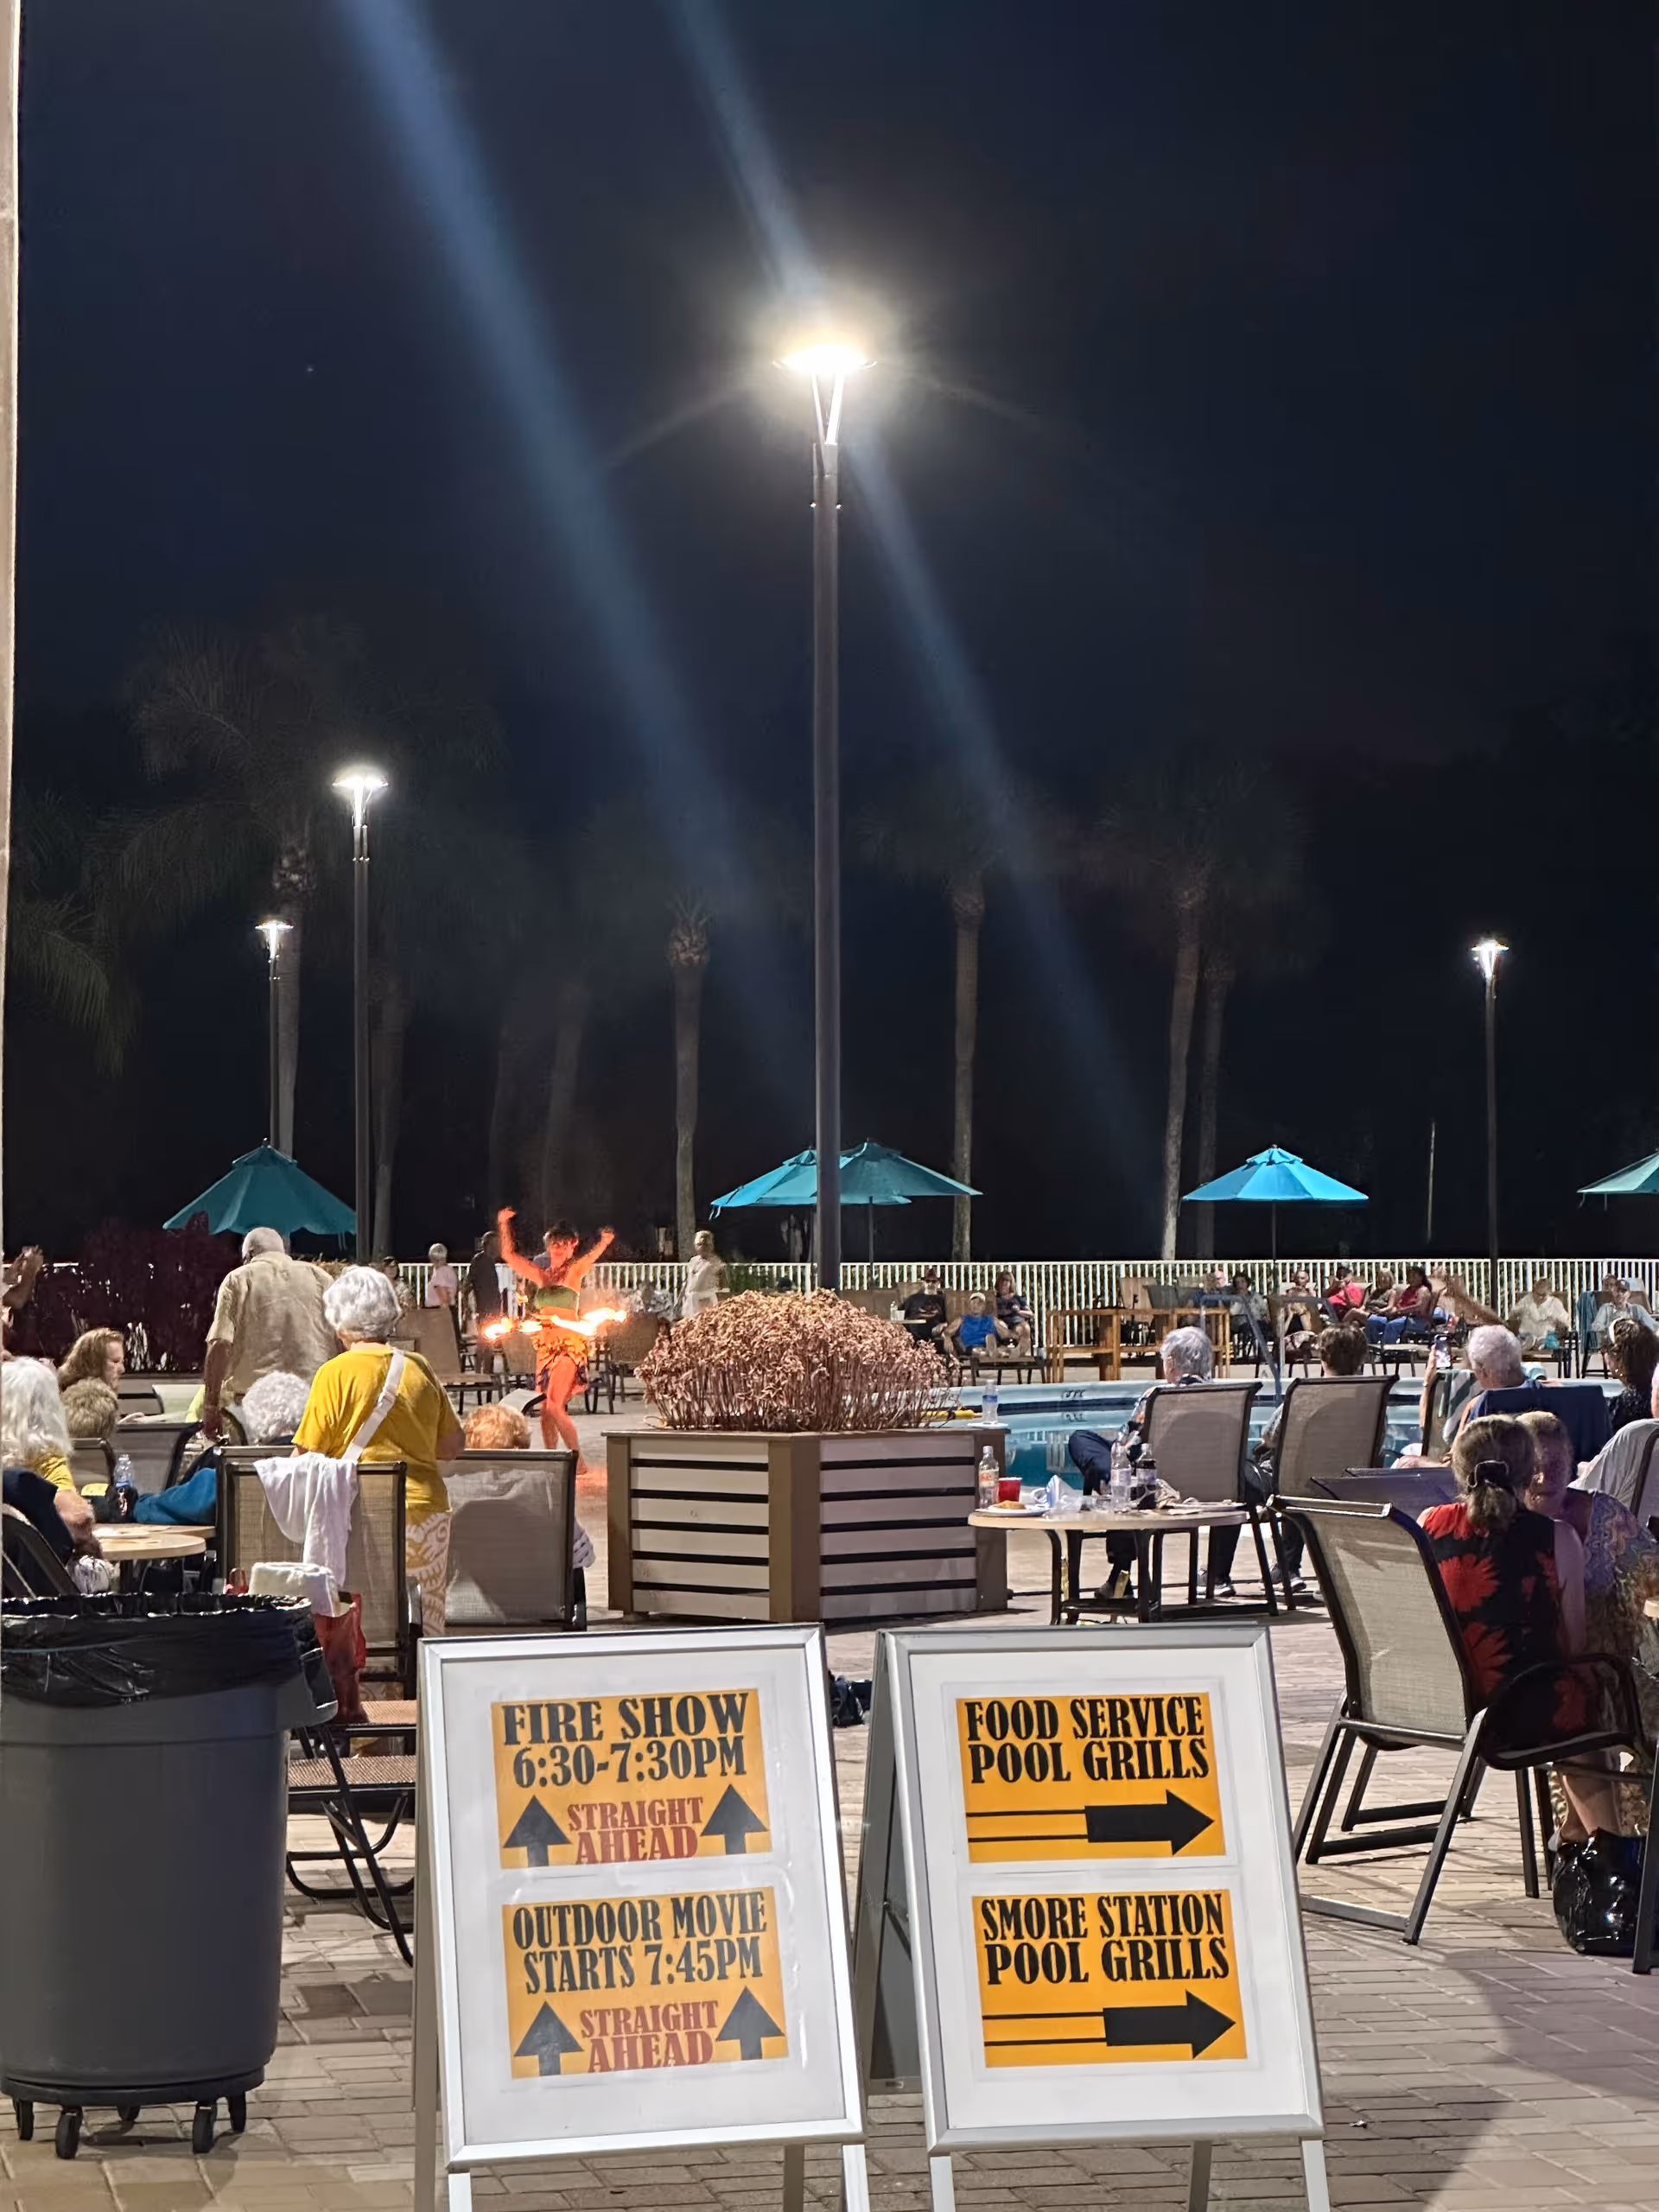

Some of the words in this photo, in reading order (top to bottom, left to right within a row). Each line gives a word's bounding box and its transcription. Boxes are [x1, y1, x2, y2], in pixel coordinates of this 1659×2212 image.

[502, 1702, 604, 1745] FIRE
[620, 1693, 748, 1738] SHOW
[963, 1700, 1058, 1740] FOOD
[1070, 1696, 1205, 1739] SERVICE
[513, 1736, 747, 1788] 6:30-7:30PM
[969, 1742, 1071, 1783] POOL
[1083, 1738, 1209, 1781] GRILLS
[567, 1798, 703, 1831] STRAIGHT
[575, 1827, 697, 1865] AHEAD
[513, 1900, 661, 1949] OUTDOOR
[671, 1891, 767, 1937] MOVIE
[982, 1897, 1088, 1941] SMORE
[1099, 1894, 1224, 1938] STATION
[524, 1944, 635, 1994] STARTS
[644, 1937, 763, 1986] 7:45PM
[985, 1942, 1089, 1985] POOL
[1102, 1937, 1230, 1981] GRILLS
[580, 2001, 719, 2037] STRAIGHT
[589, 2032, 713, 2073] AHEAD
